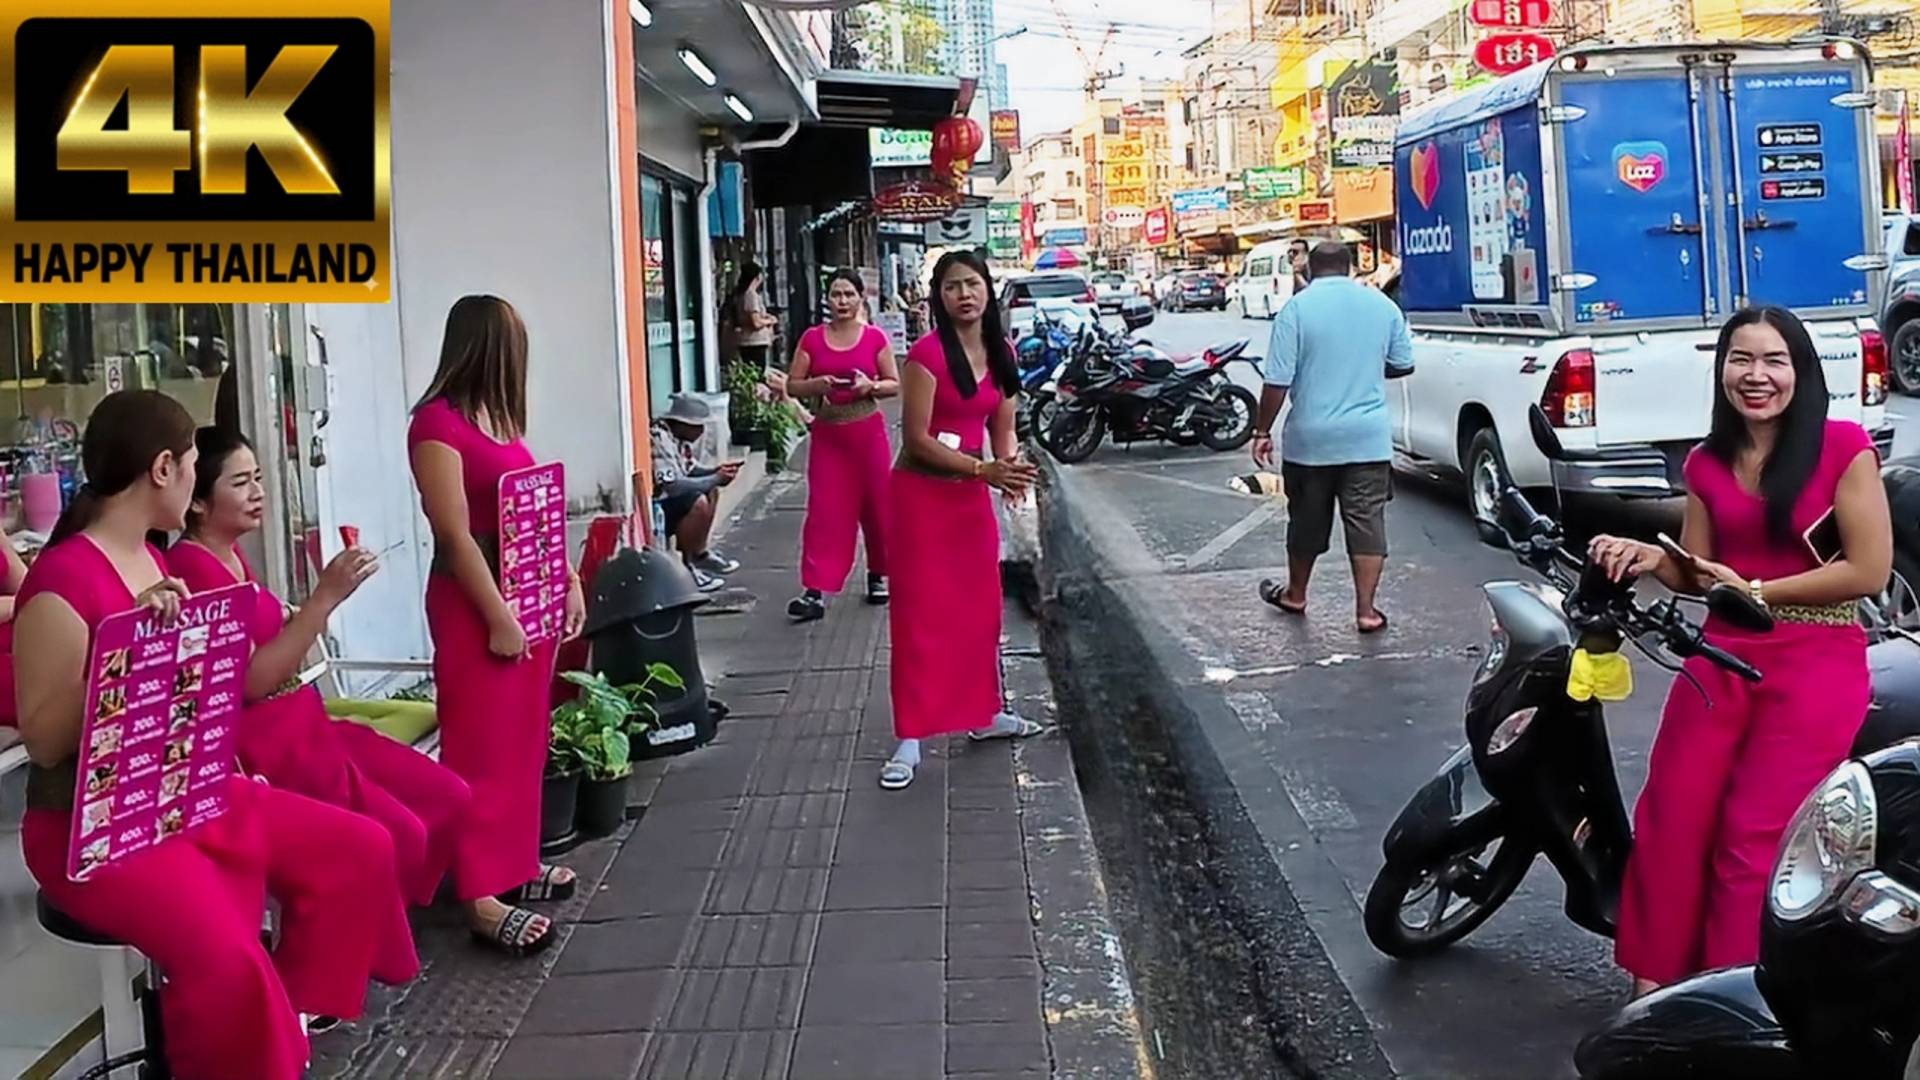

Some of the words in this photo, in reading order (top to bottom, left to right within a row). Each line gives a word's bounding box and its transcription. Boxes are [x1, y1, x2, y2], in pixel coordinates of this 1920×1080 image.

[1627, 163, 1657, 180] Laz
[1403, 215, 1452, 255] Lazada
[132, 598, 232, 642] MSAGE
